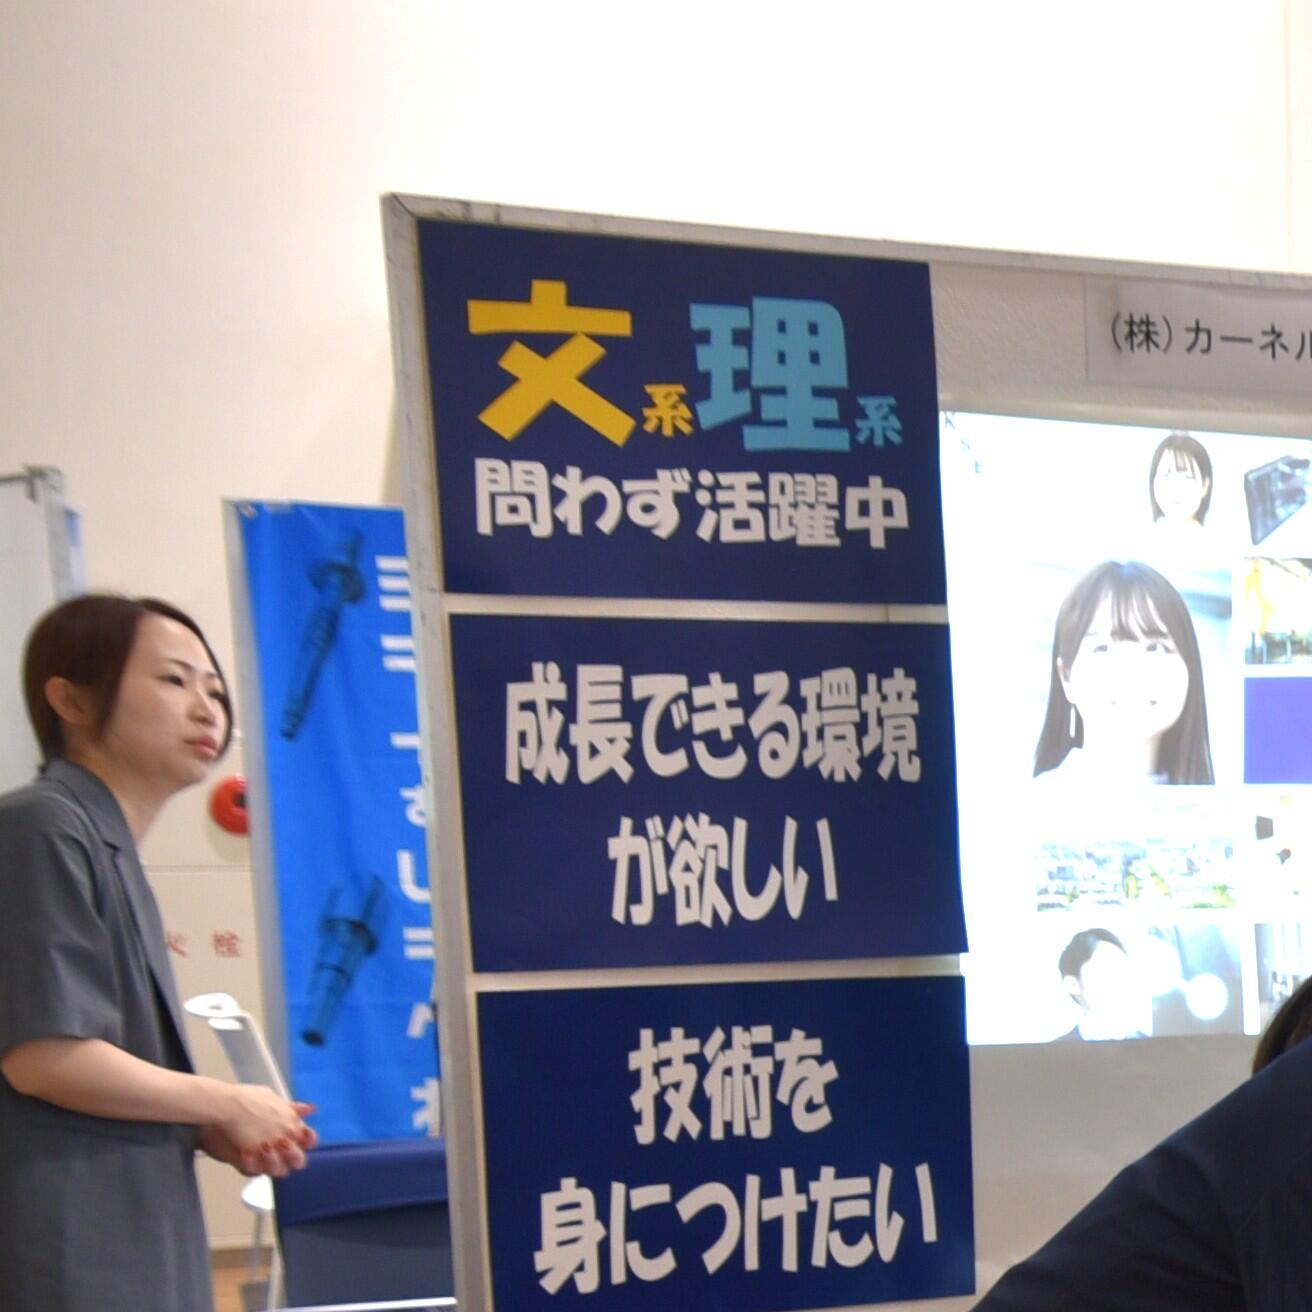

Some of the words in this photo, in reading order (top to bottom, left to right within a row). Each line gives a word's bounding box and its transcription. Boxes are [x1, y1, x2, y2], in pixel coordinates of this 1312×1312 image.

[474, 457, 910, 549] 問わず活躍中
[505, 660, 922, 786] 成長できる環境
[608, 812, 839, 927] が欲しい
[629, 1025, 839, 1145] 技術を
[534, 1162, 937, 1295] 身につけたい
